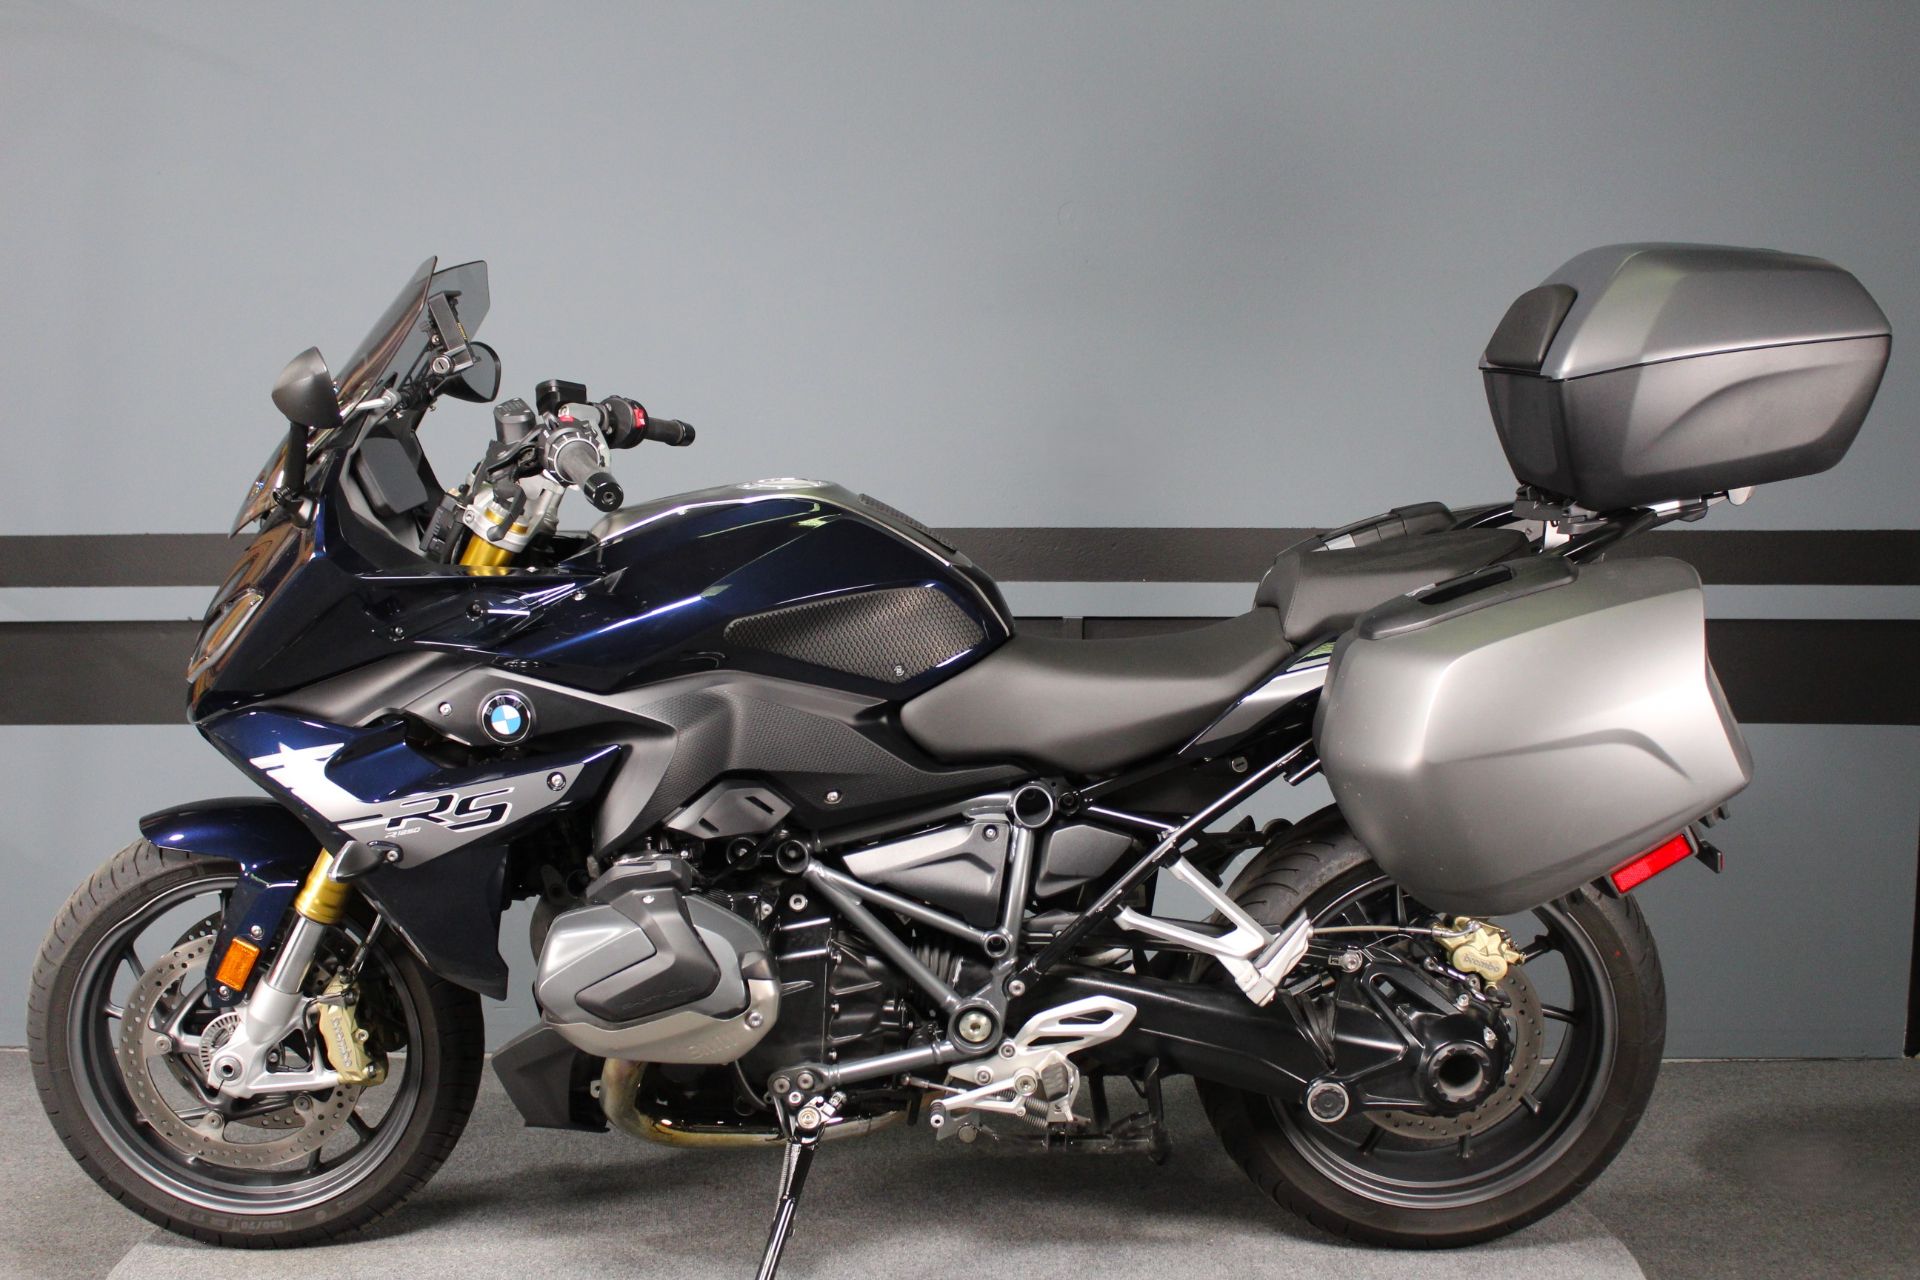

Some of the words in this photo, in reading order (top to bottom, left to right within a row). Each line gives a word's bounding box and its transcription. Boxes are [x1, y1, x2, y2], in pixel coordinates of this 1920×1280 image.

[485, 696, 524, 716] BMW
[385, 787, 515, 833] RS
[1463, 952, 1500, 972] brembo
